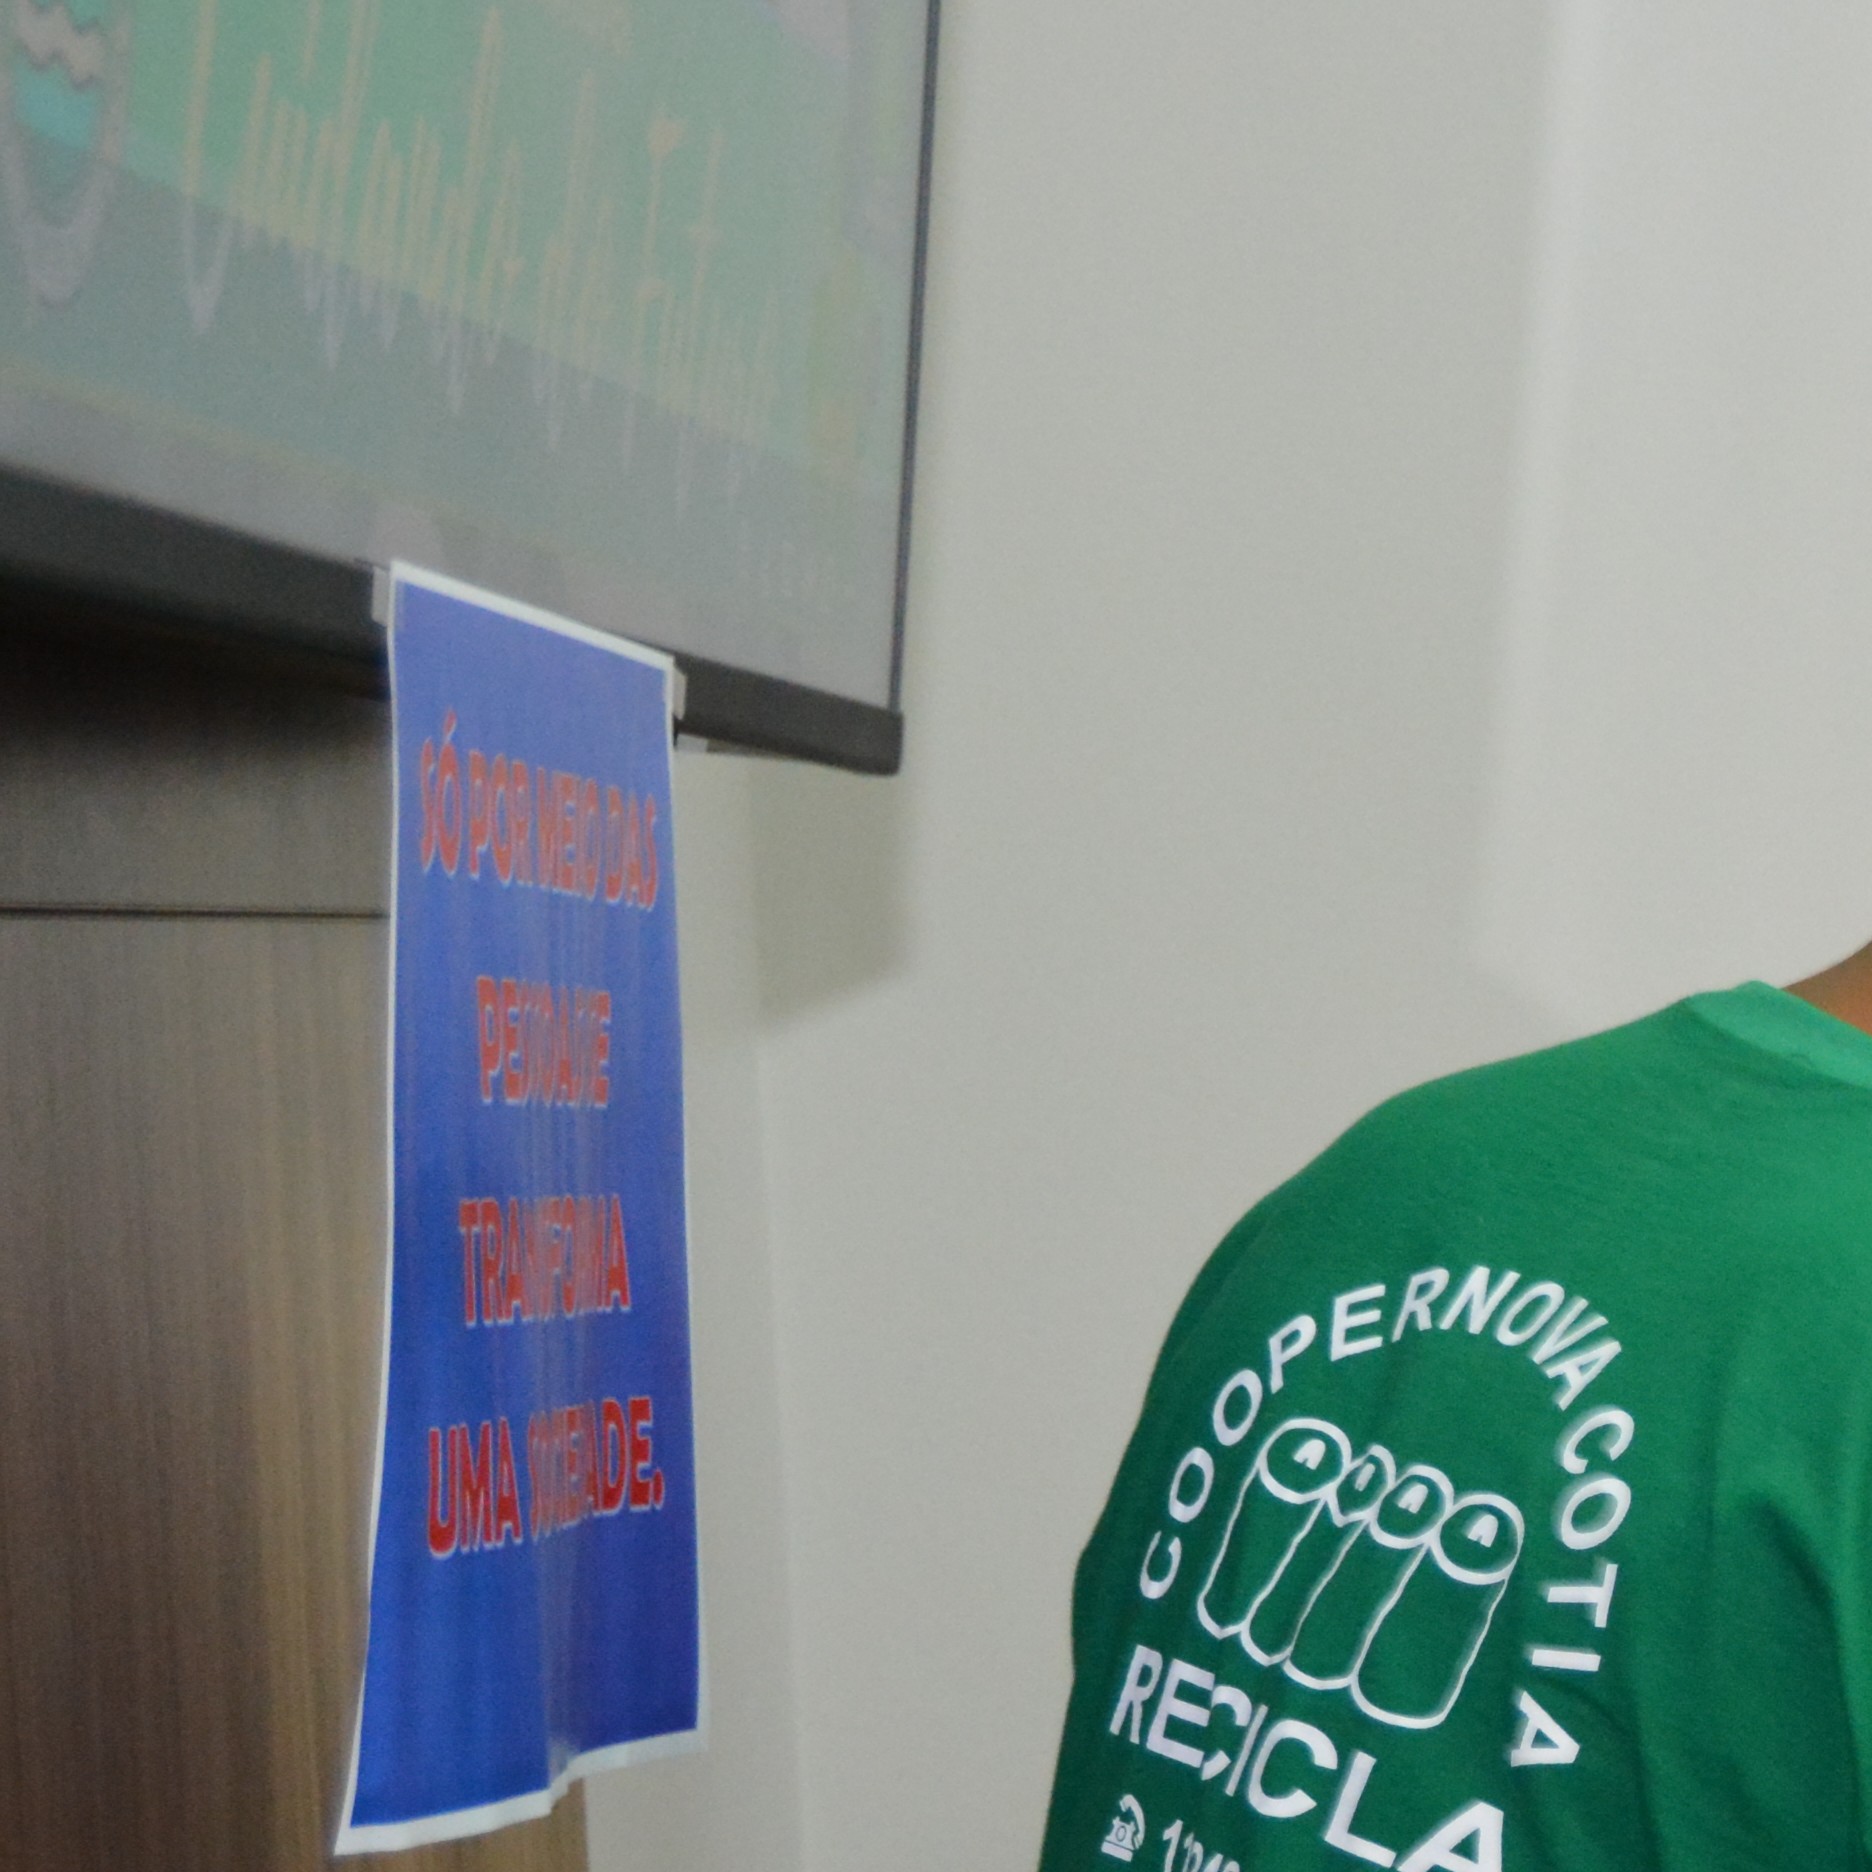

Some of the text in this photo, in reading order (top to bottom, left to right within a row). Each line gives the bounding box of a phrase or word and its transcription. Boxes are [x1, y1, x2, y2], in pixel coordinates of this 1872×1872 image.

[419, 706, 462, 877] SÓ
[466, 747, 534, 889] POR
[603, 783, 658, 913] DAS
[427, 1415, 524, 1560] UMA
[1138, 1264, 1637, 1768] COOPERNOVA COTIA
